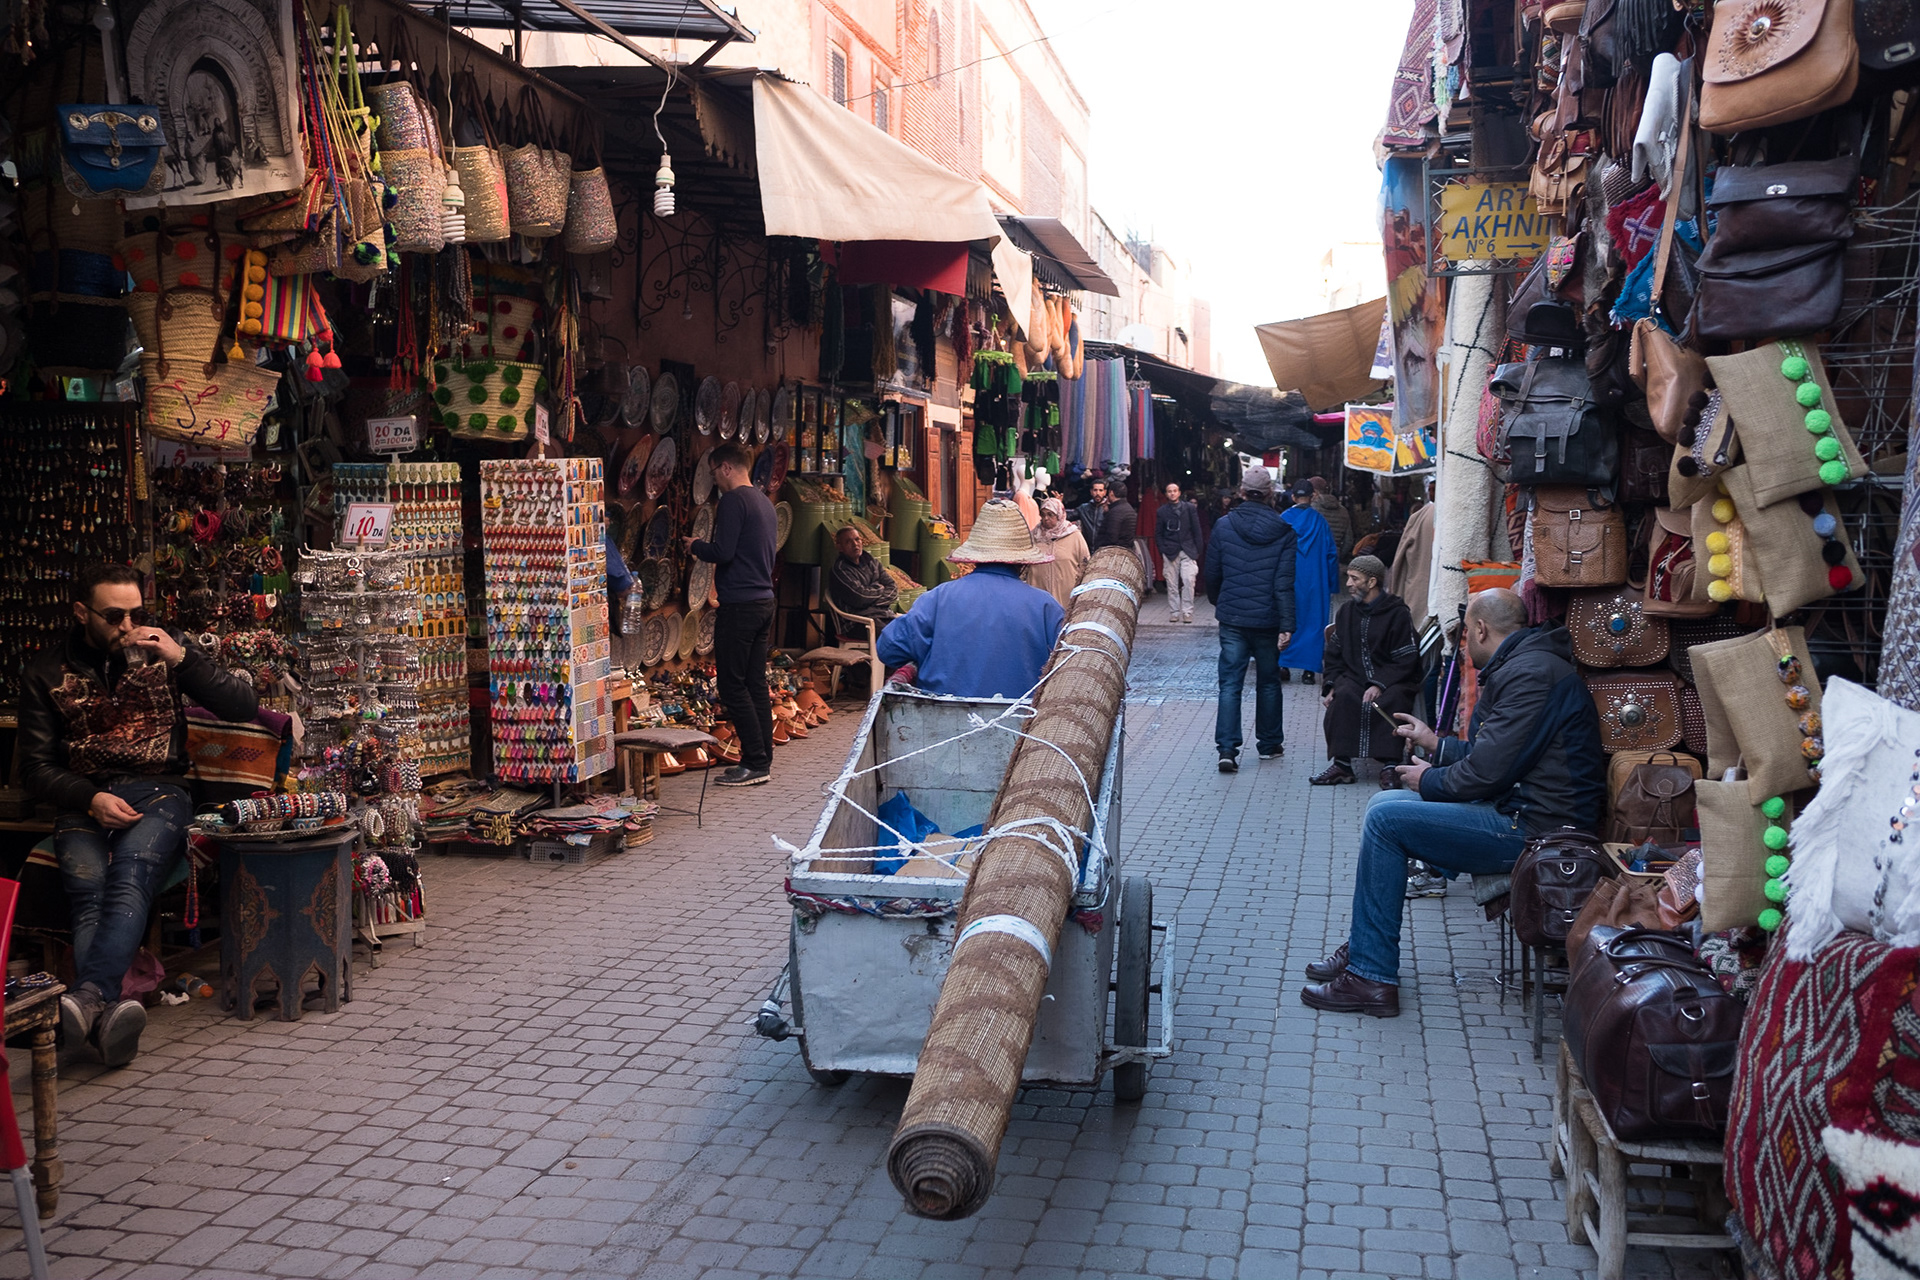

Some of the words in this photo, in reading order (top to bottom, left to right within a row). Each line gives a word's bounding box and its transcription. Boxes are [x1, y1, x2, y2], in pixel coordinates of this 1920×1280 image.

[1475, 187, 1529, 212] ART
[374, 425, 390, 438] 20
[356, 516, 375, 537] 10
